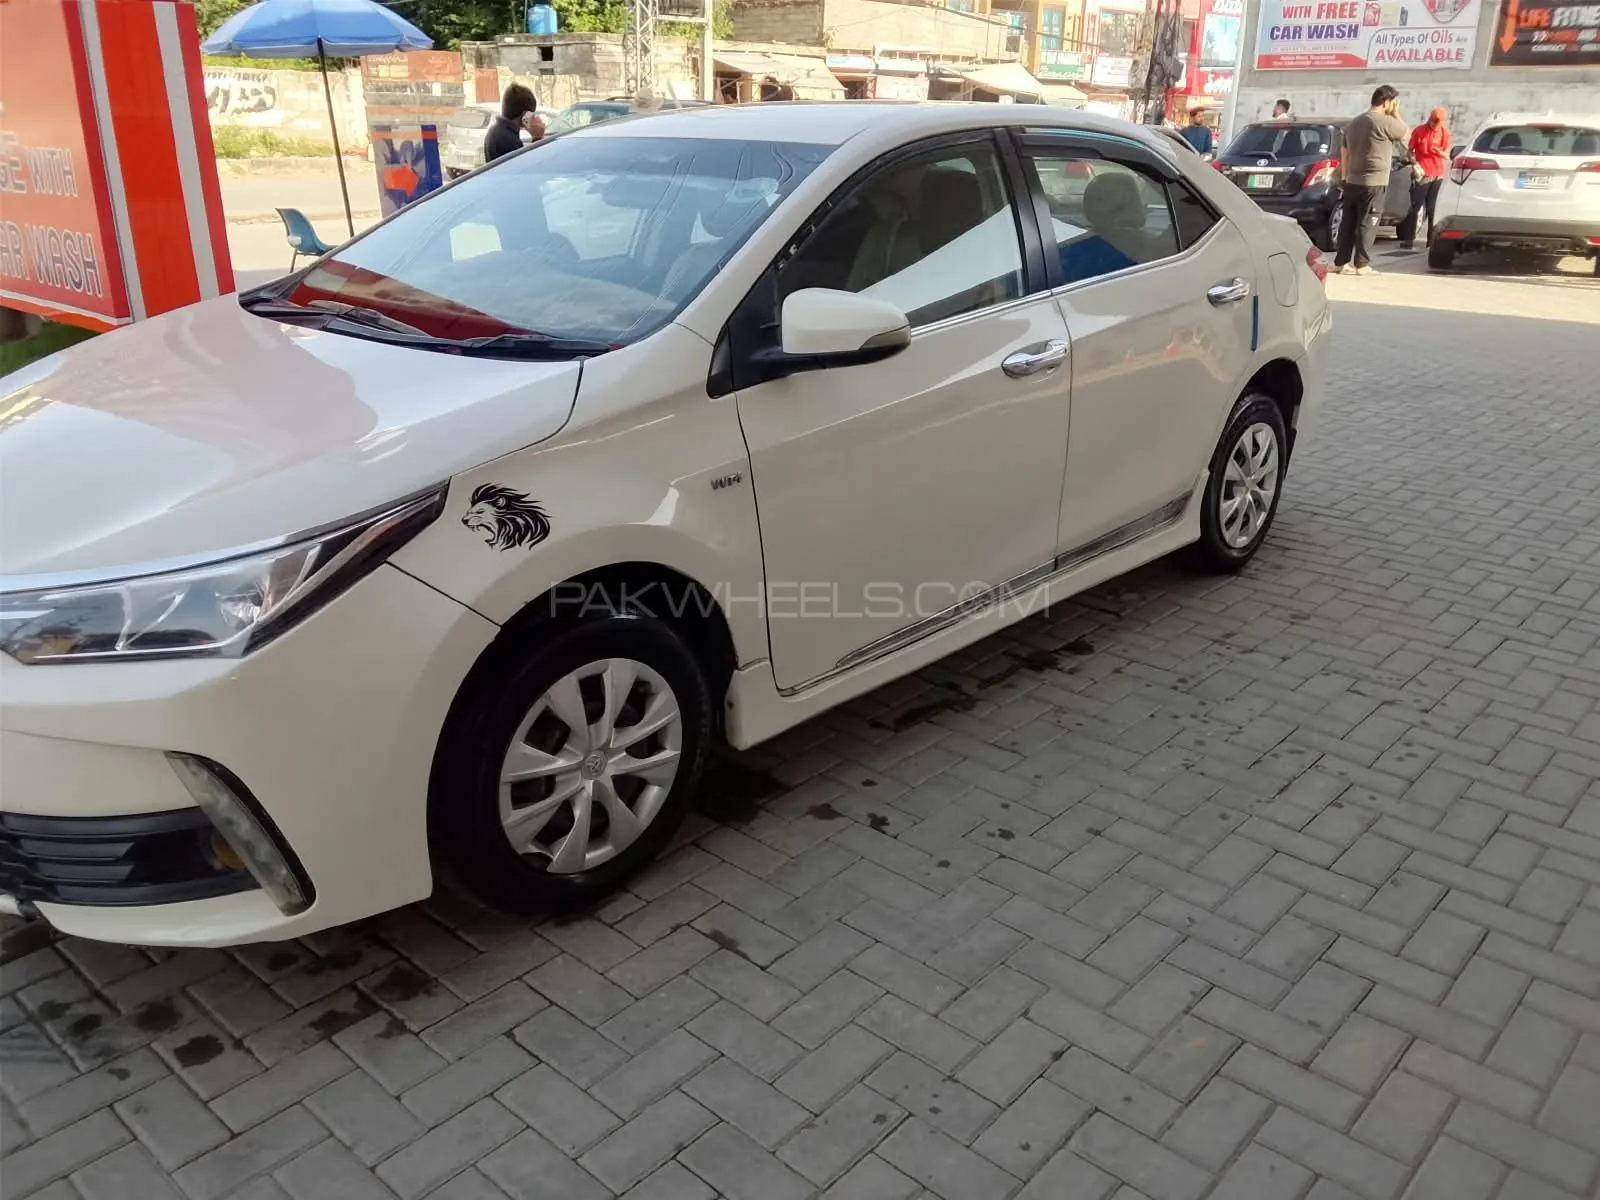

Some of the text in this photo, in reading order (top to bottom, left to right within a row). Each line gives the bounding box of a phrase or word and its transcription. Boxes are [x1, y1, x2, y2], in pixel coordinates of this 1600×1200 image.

[1282, 2, 1358, 19] WITH FREE
[1519, 9, 1551, 28] LIFE
[1269, 23, 1359, 41] CAR WASH
[1375, 33, 1388, 44] All
[1390, 34, 1415, 47] Types
[1417, 34, 1428, 44] Of
[1430, 30, 1453, 44] Oils
[1375, 47, 1466, 63] AVAILABLE
[25, 146, 79, 198] WITH
[28, 223, 102, 298] WASH
